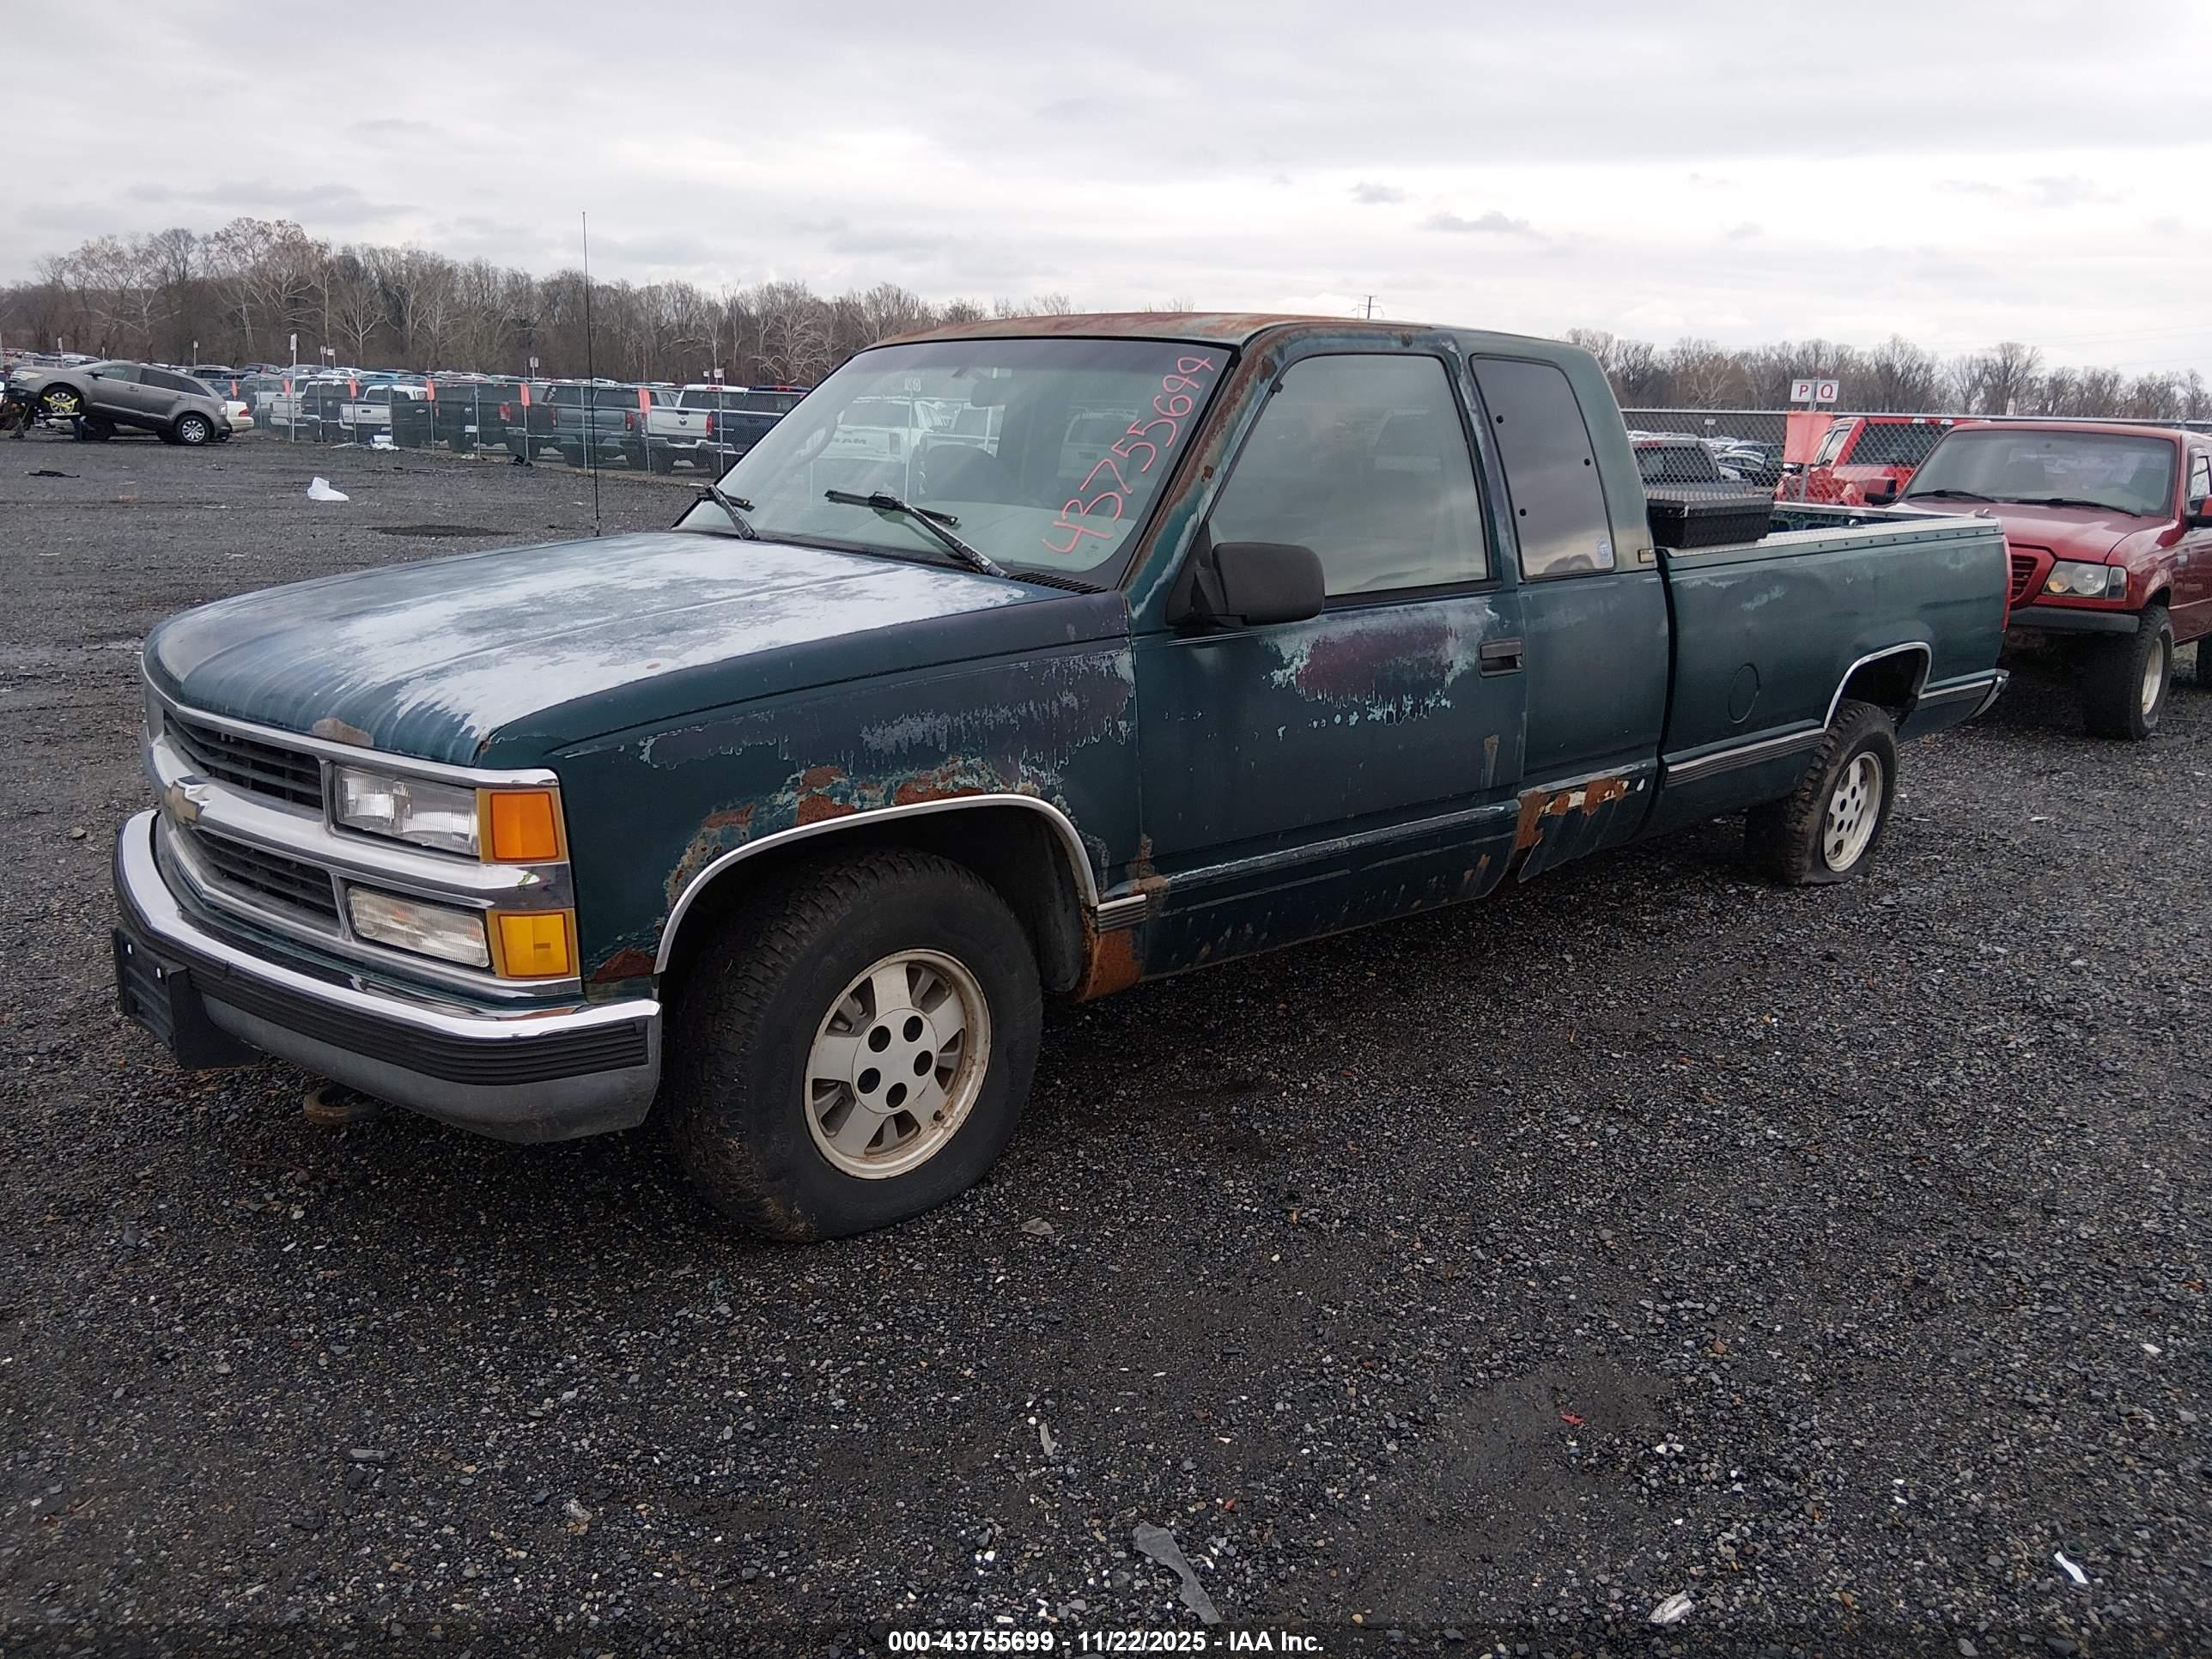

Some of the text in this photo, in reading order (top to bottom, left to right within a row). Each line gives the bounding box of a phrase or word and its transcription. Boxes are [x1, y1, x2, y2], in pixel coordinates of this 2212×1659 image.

[1798, 384, 1809, 398] P
[1820, 384, 1833, 398] Q
[1042, 355, 1215, 555] 43755699
